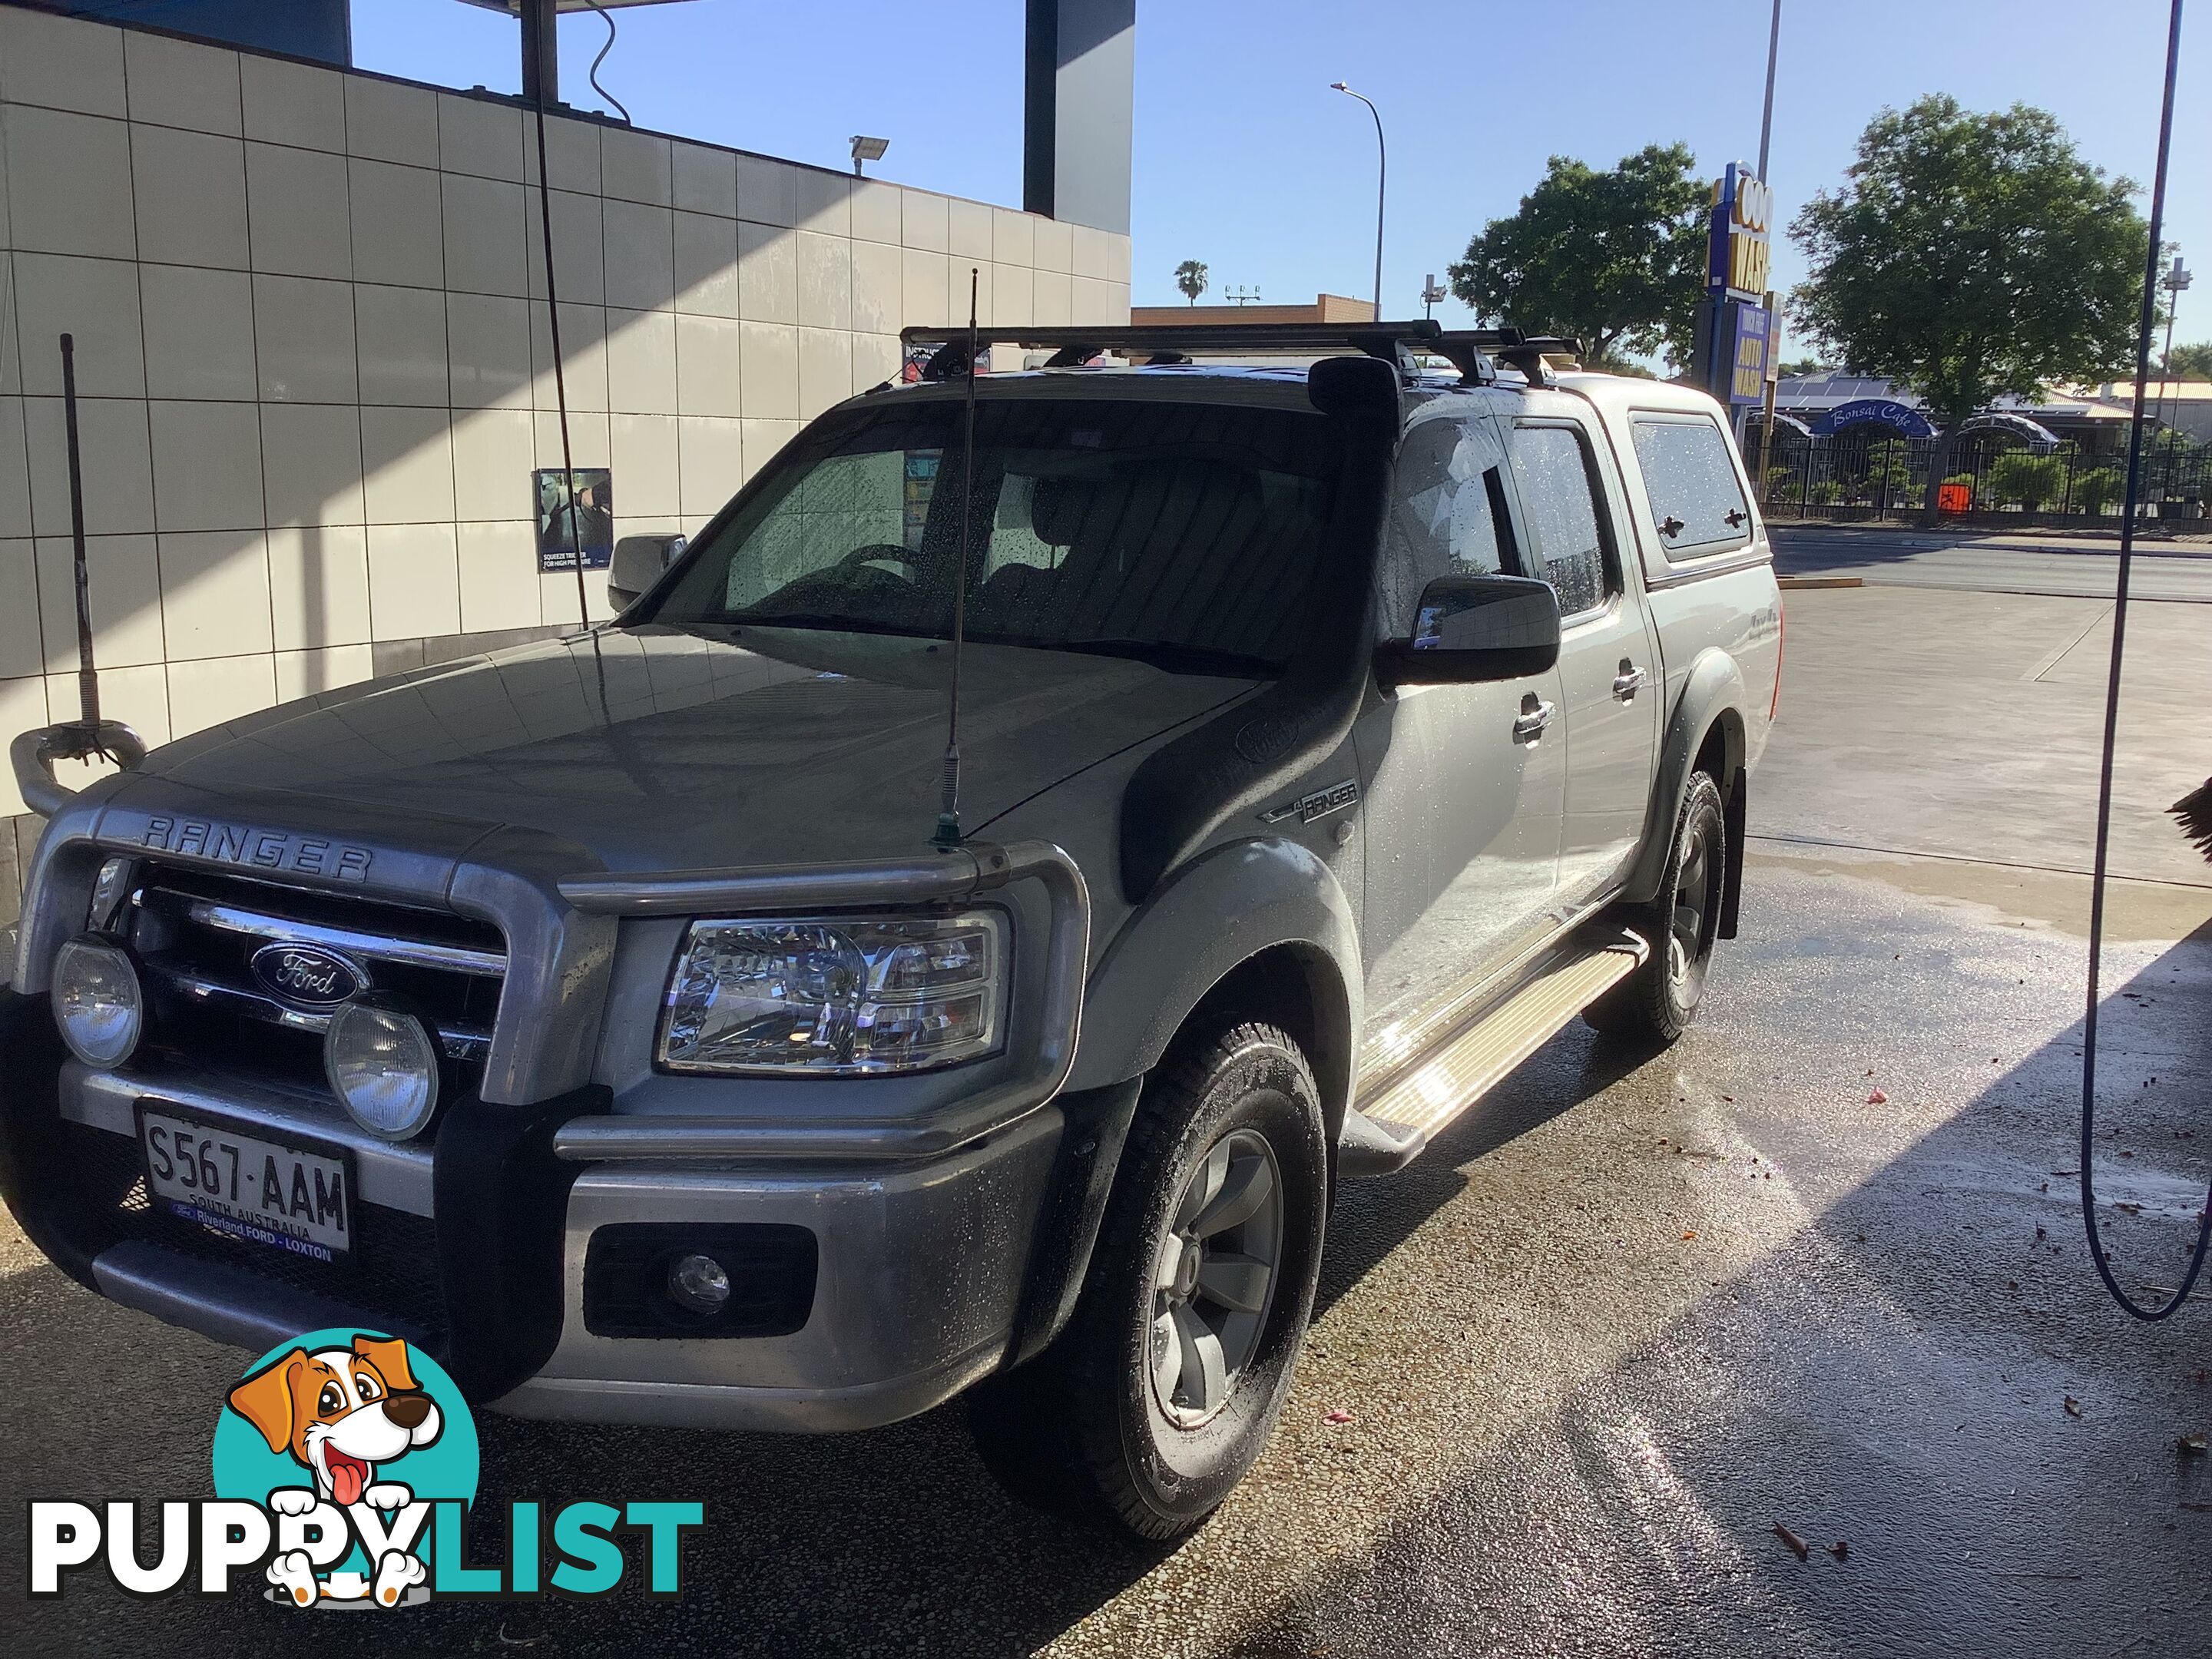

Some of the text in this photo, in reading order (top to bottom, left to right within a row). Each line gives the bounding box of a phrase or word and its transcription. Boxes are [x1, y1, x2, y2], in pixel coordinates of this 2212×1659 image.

[1735, 233, 1771, 295] WASH
[1738, 336, 1763, 368] AUTO
[1734, 367, 1761, 398] WASH
[1831, 404, 1911, 427] Bonsai Cafe
[543, 552, 565, 561] SQUEEZE
[568, 558, 591, 566] PREURE
[1304, 783, 1357, 819] RANGER
[141, 815, 373, 883] RANGER
[276, 951, 337, 995] Ford
[190, 1194, 313, 1241] SOUTH AUSTRALIA
[246, 1227, 275, 1244] FORD
[285, 1237, 332, 1262] LOXTON
